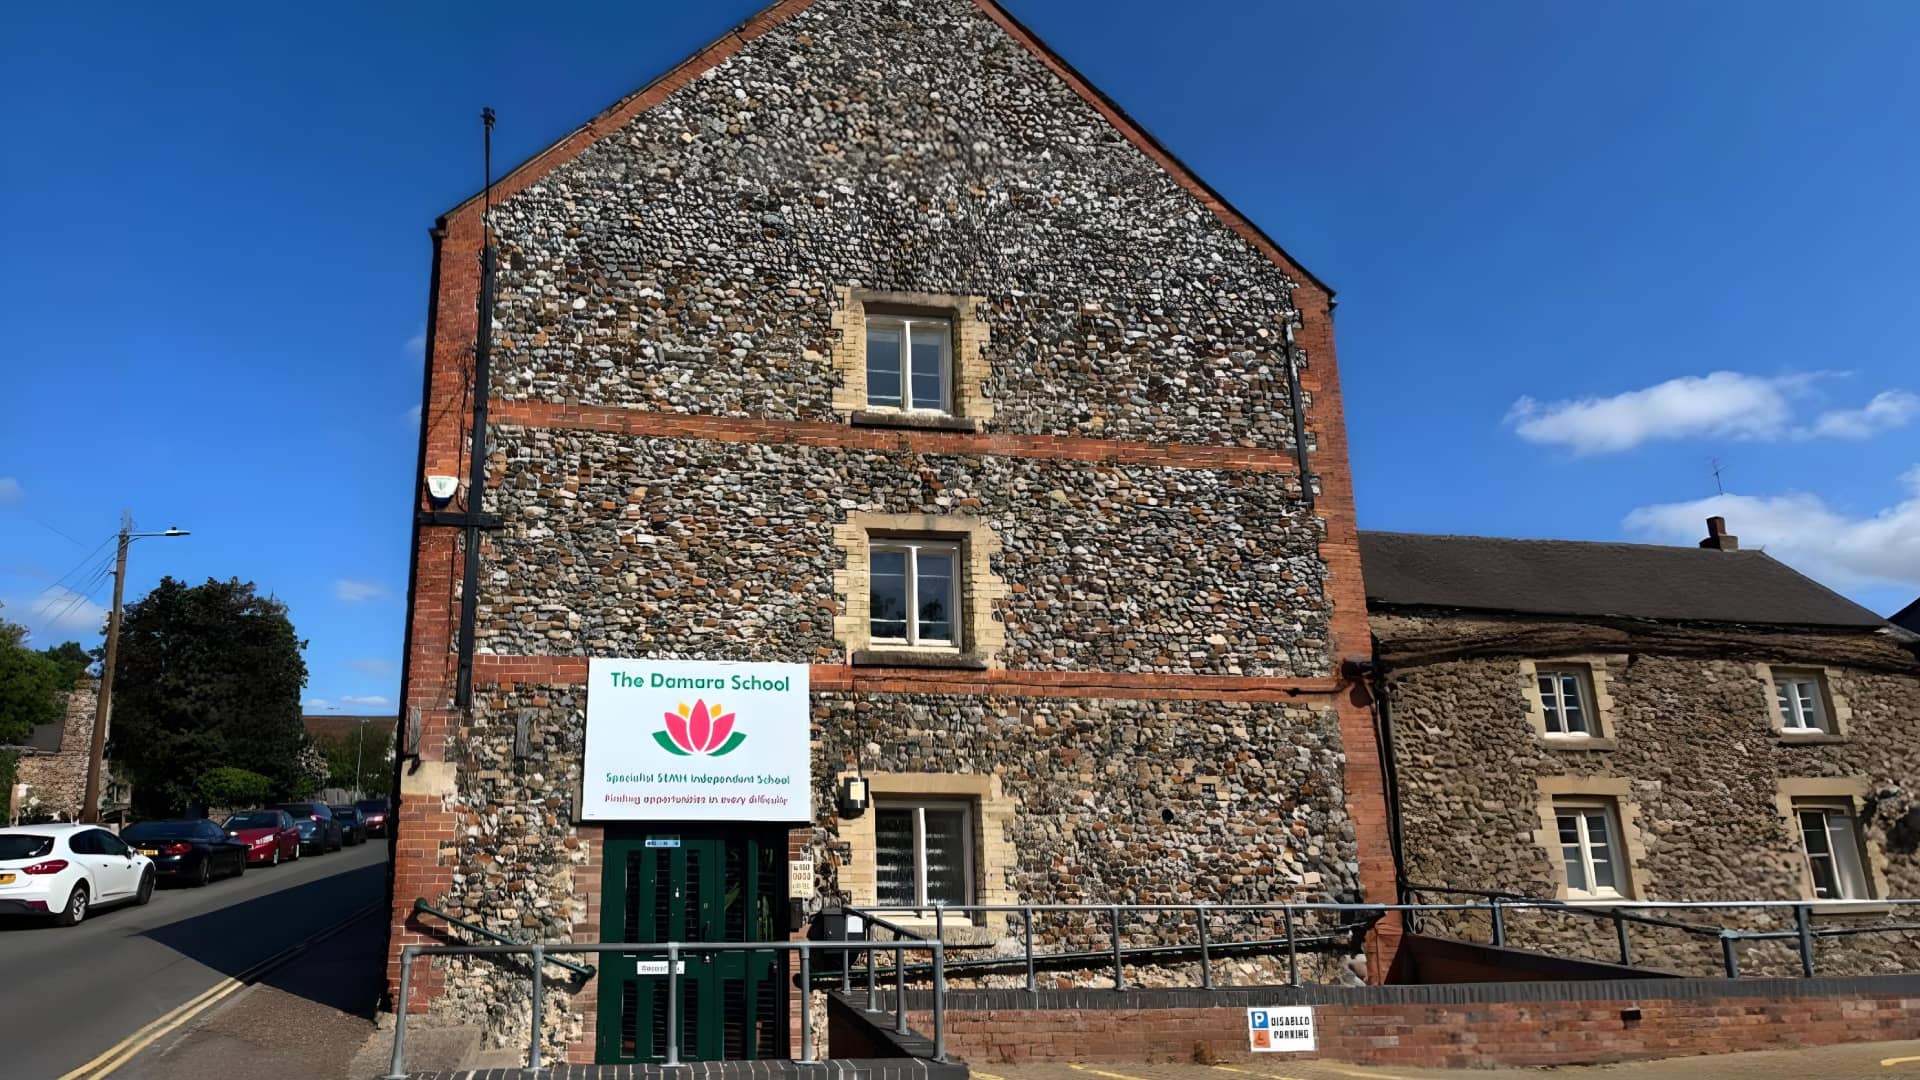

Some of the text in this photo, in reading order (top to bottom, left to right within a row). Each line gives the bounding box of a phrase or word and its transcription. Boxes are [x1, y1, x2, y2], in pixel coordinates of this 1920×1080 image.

[610, 671, 790, 692] The Damara School
[606, 772, 654, 785] Specialist
[690, 773, 755, 786] Independent
[757, 773, 790, 785] School
[708, 795, 719, 804] in
[720, 796, 746, 806] every
[1254, 1012, 1265, 1027] P
[1271, 1016, 1310, 1026] DISABLED
[1273, 1029, 1309, 1039] PARKING
